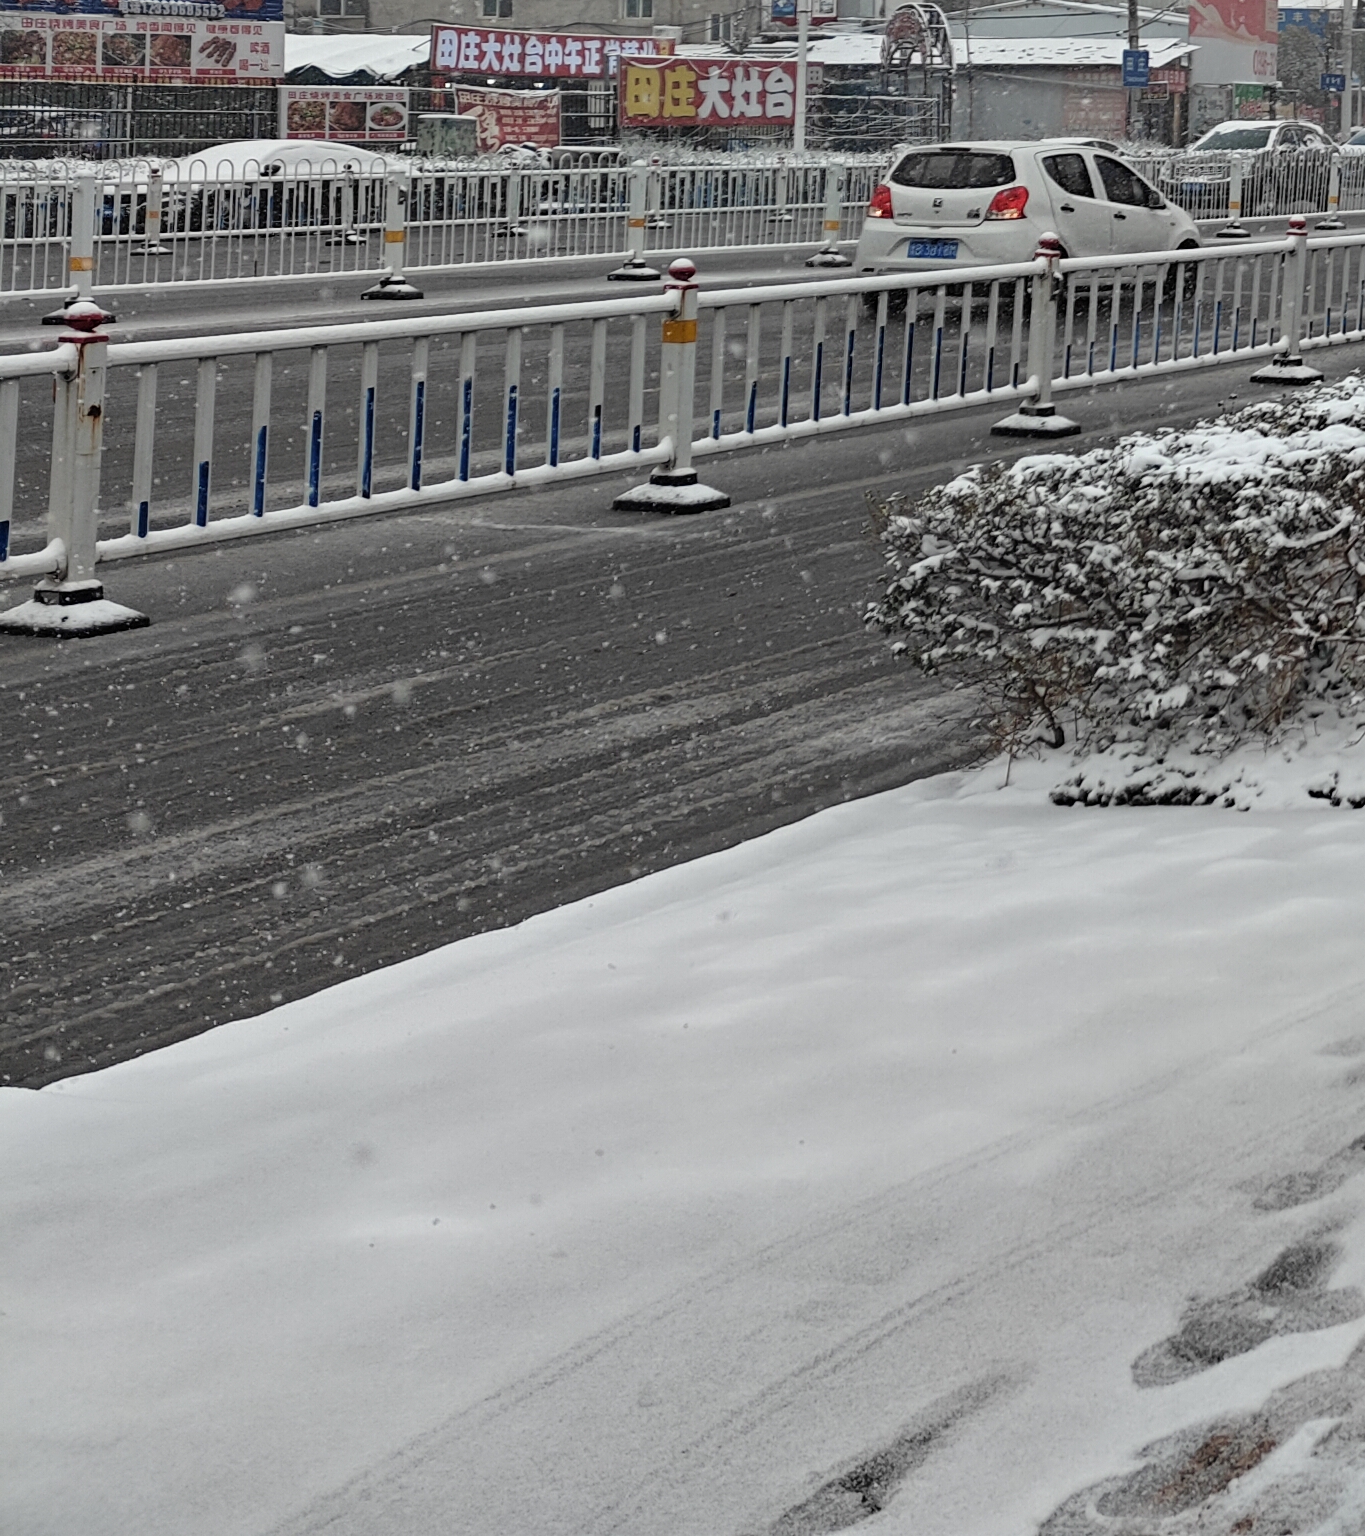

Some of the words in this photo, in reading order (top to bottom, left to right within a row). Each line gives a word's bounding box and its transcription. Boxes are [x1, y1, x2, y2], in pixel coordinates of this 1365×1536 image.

[625, 66, 794, 119] 田庄大灶台
